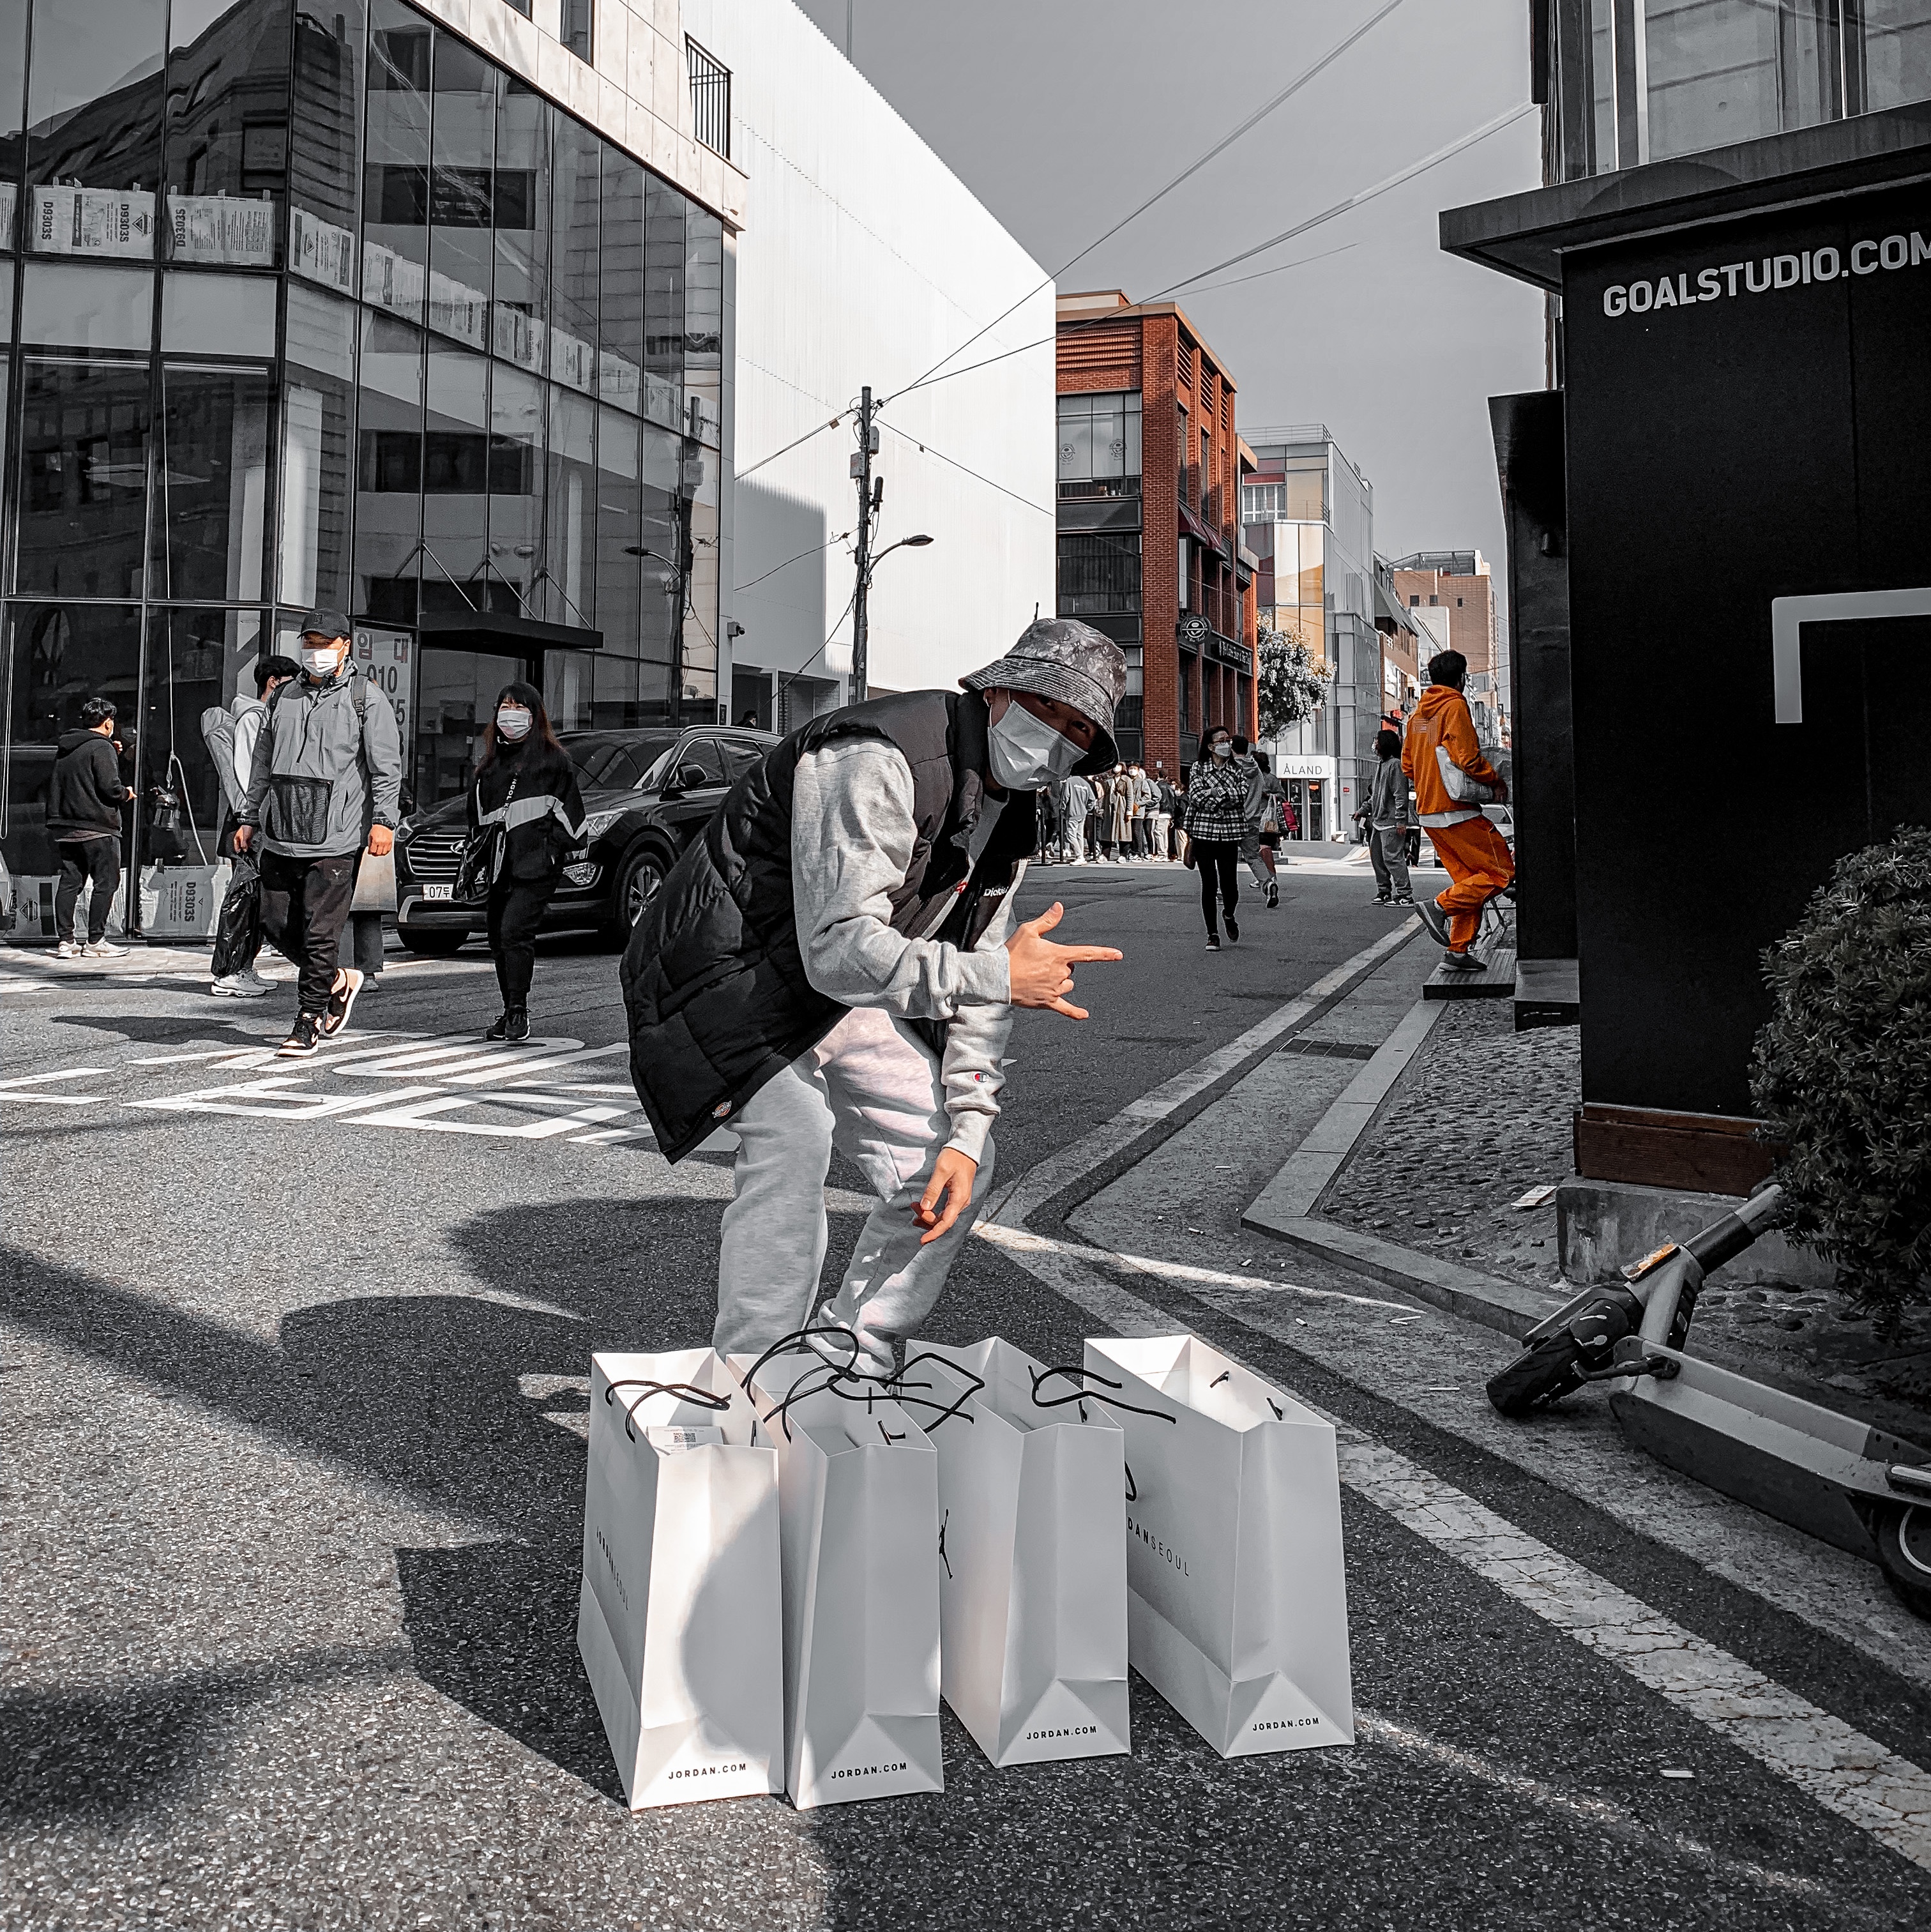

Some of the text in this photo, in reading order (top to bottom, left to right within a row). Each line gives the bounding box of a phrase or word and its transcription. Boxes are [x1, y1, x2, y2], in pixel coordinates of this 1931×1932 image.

[1603, 231, 1931, 317] GOALSTUDIO.COM
[1284, 763, 1322, 775] ÅLAND
[185, 881, 197, 922] D9303S
[1252, 1717, 1319, 1731] JORDAN.COM
[1026, 1726, 1097, 1740] JORDAN.COM
[668, 1763, 746, 1779] JORDAN.COM
[831, 1762, 907, 1779] JORDAN.COM
